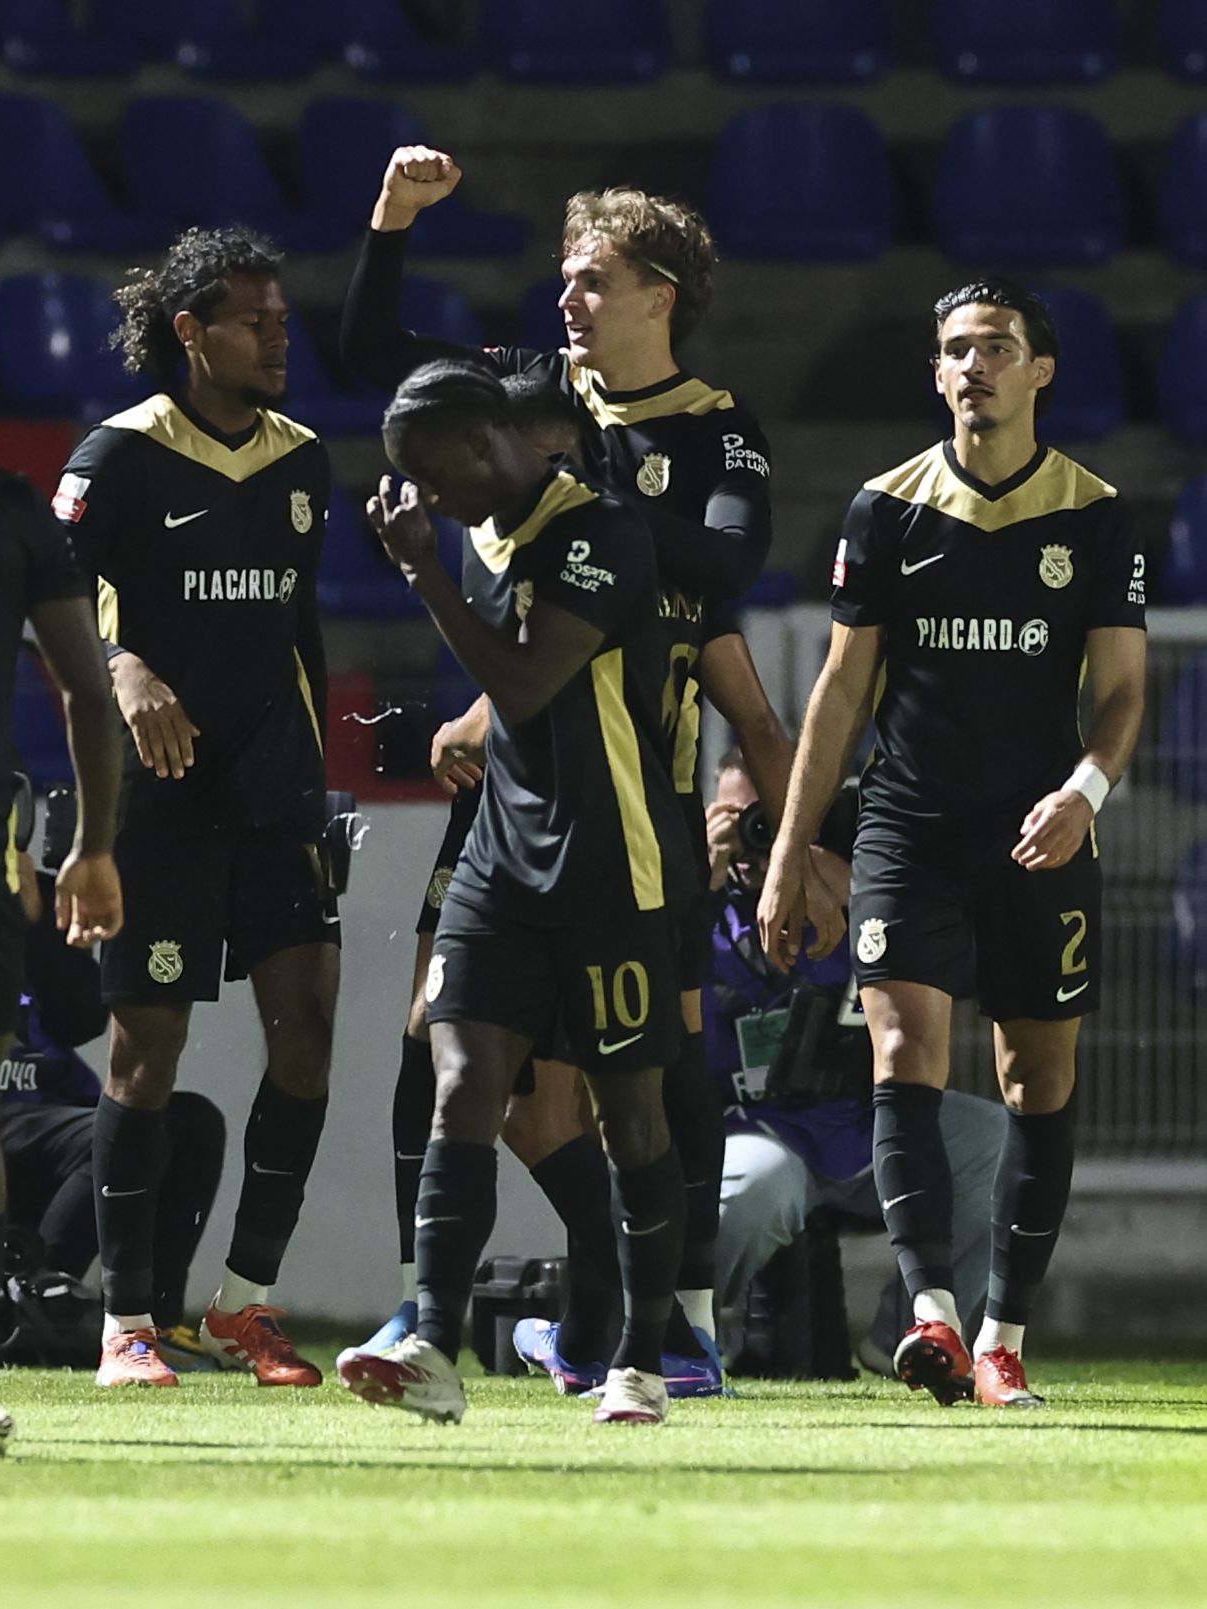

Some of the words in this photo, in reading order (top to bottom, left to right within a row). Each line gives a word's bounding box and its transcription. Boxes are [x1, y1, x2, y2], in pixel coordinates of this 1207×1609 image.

[725, 449, 770, 477] HOSPITA
[725, 459, 744, 470] DA
[747, 460, 765, 477] LUZ
[1059, 909, 1087, 976] 2
[587, 961, 649, 1029] 10
